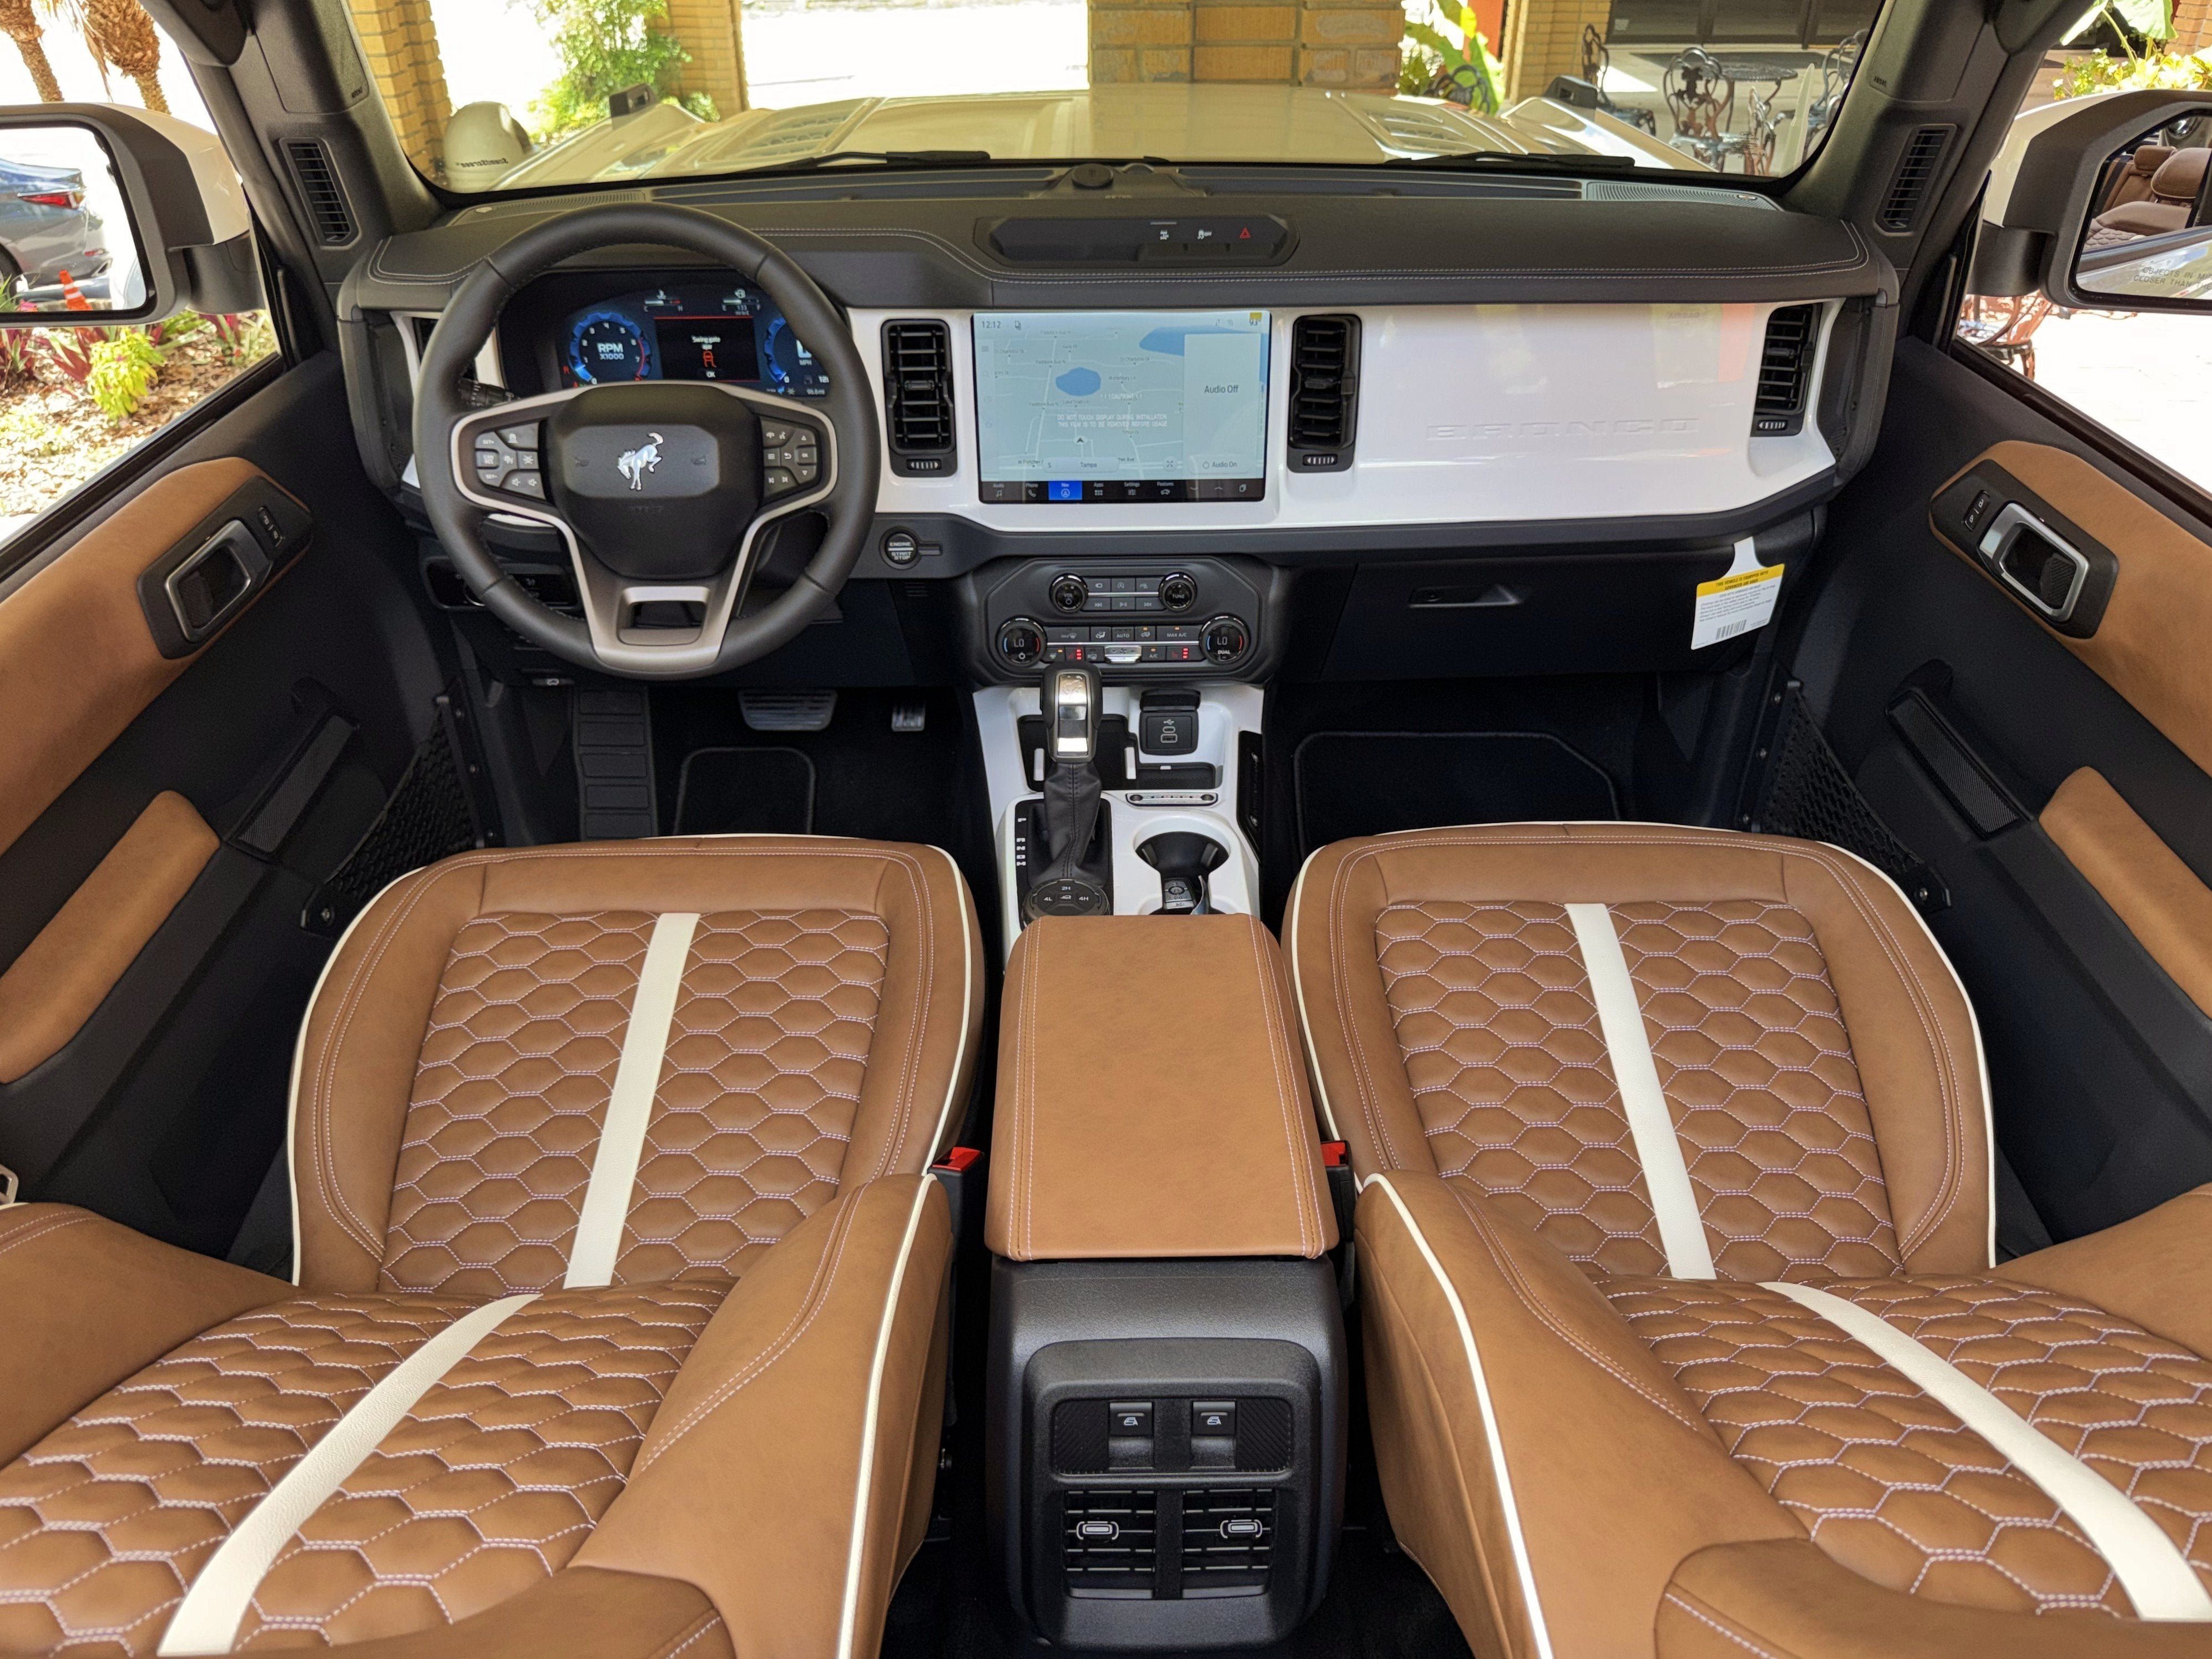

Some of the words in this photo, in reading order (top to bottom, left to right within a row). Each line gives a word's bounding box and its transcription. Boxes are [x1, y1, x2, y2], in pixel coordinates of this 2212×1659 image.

[2142, 266, 2180, 277] OBJECTS
[2133, 275, 2165, 284] CLOSER
[597, 342, 624, 353] RPM
[1227, 385, 1239, 393] Off
[1426, 418, 1700, 441] BRONCO
[1014, 639, 1024, 647] LO
[1217, 636, 1228, 645] LO
